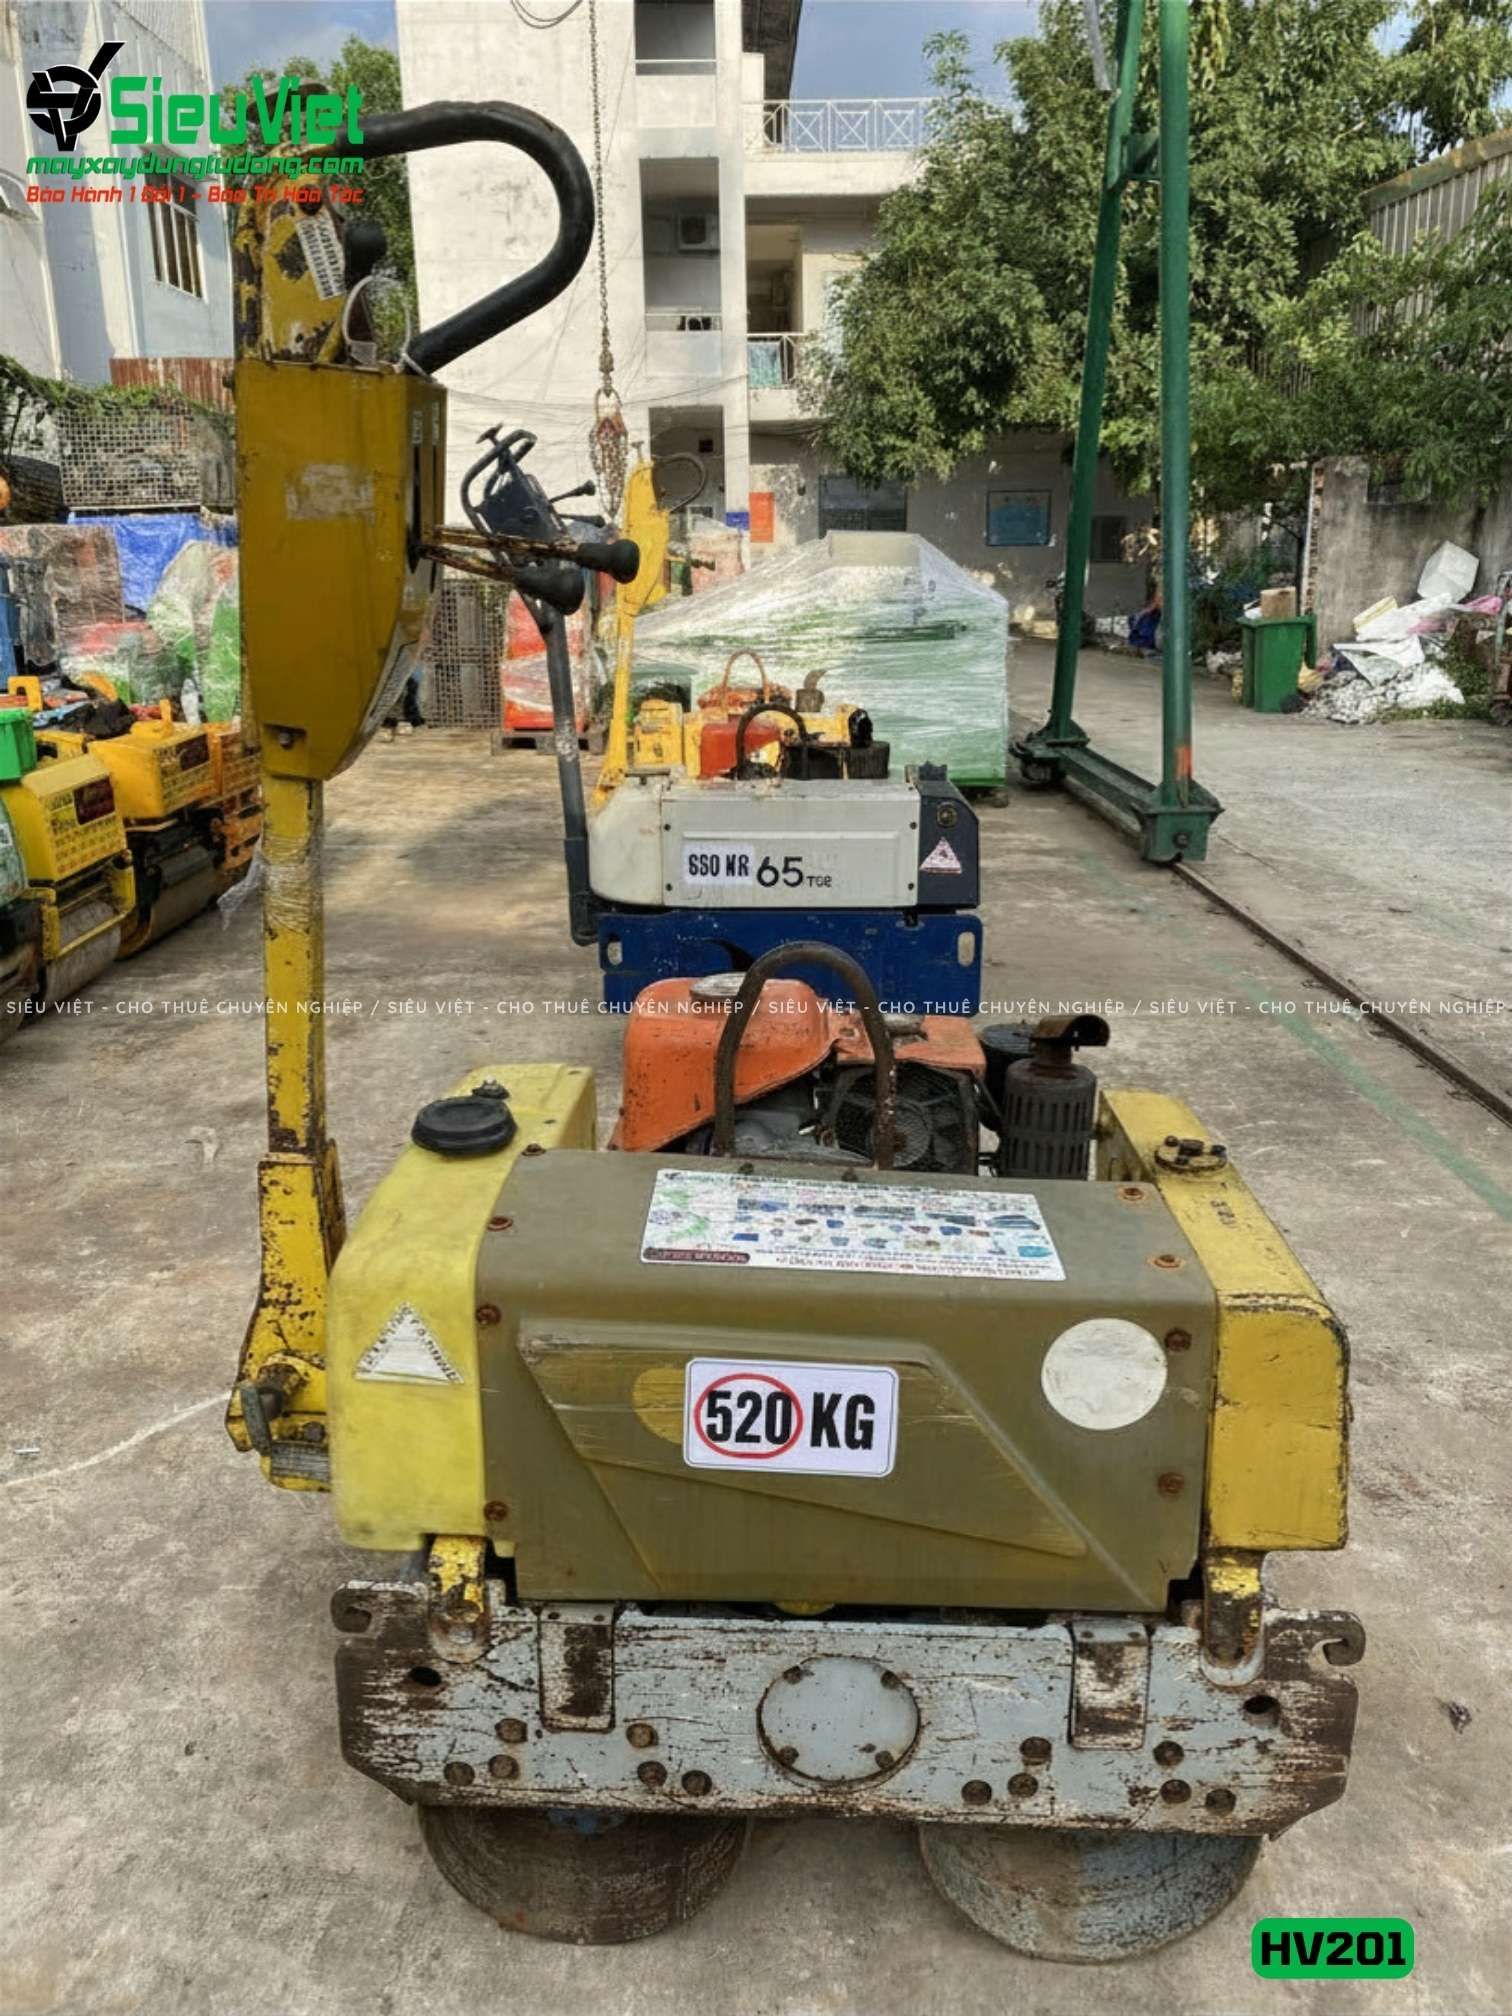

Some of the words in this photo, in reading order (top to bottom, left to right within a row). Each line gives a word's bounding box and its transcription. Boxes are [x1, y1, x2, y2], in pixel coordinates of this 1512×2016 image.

[756, 856, 804, 888] 65
[706, 1390, 793, 1445] 520
[810, 1392, 876, 1450] KG
